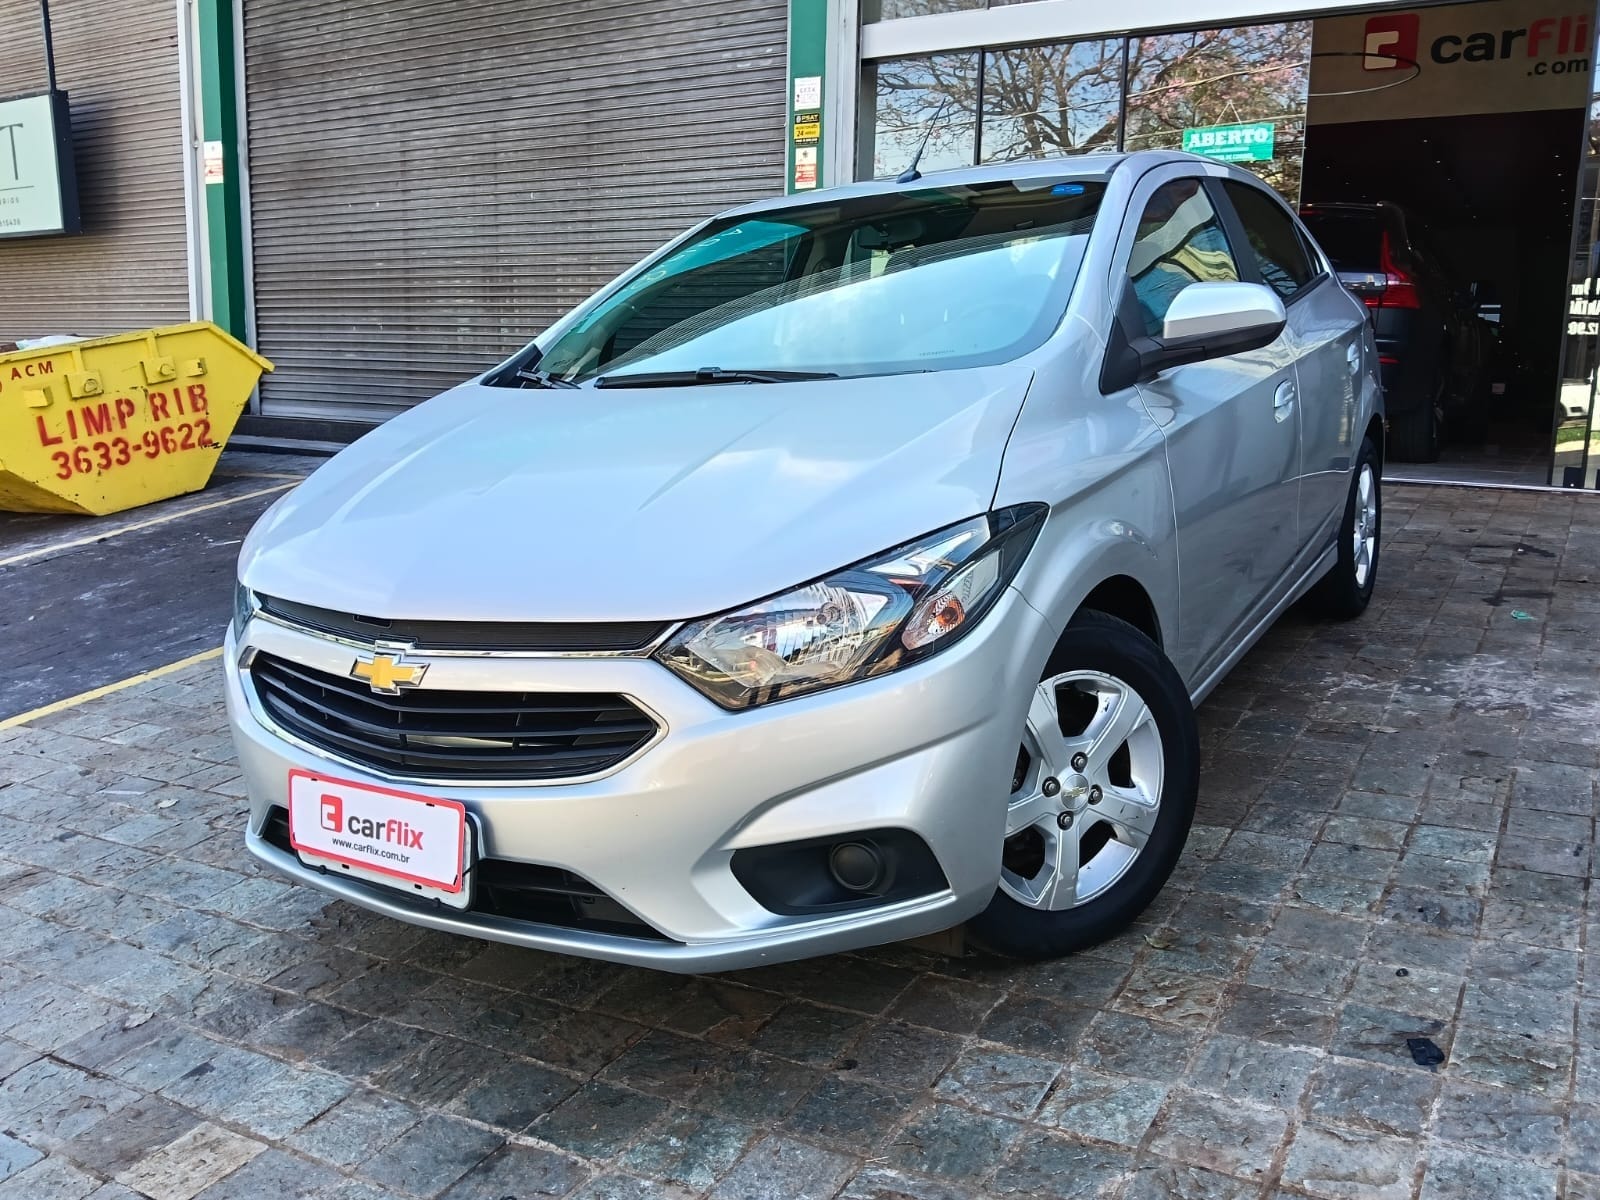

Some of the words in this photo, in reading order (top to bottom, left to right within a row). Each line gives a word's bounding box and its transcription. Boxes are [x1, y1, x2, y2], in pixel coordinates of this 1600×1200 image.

[1430, 14, 1592, 64] carfli
[1527, 58, 1589, 76] .com
[1188, 127, 1268, 148] ABERTO
[11, 360, 54, 380] ACM
[36, 397, 135, 447] LIMP
[149, 383, 208, 422] RIB
[51, 418, 214, 480] 3633-9622
[348, 816, 424, 850] carflix
[332, 838, 410, 863] www.carflix.com.br
